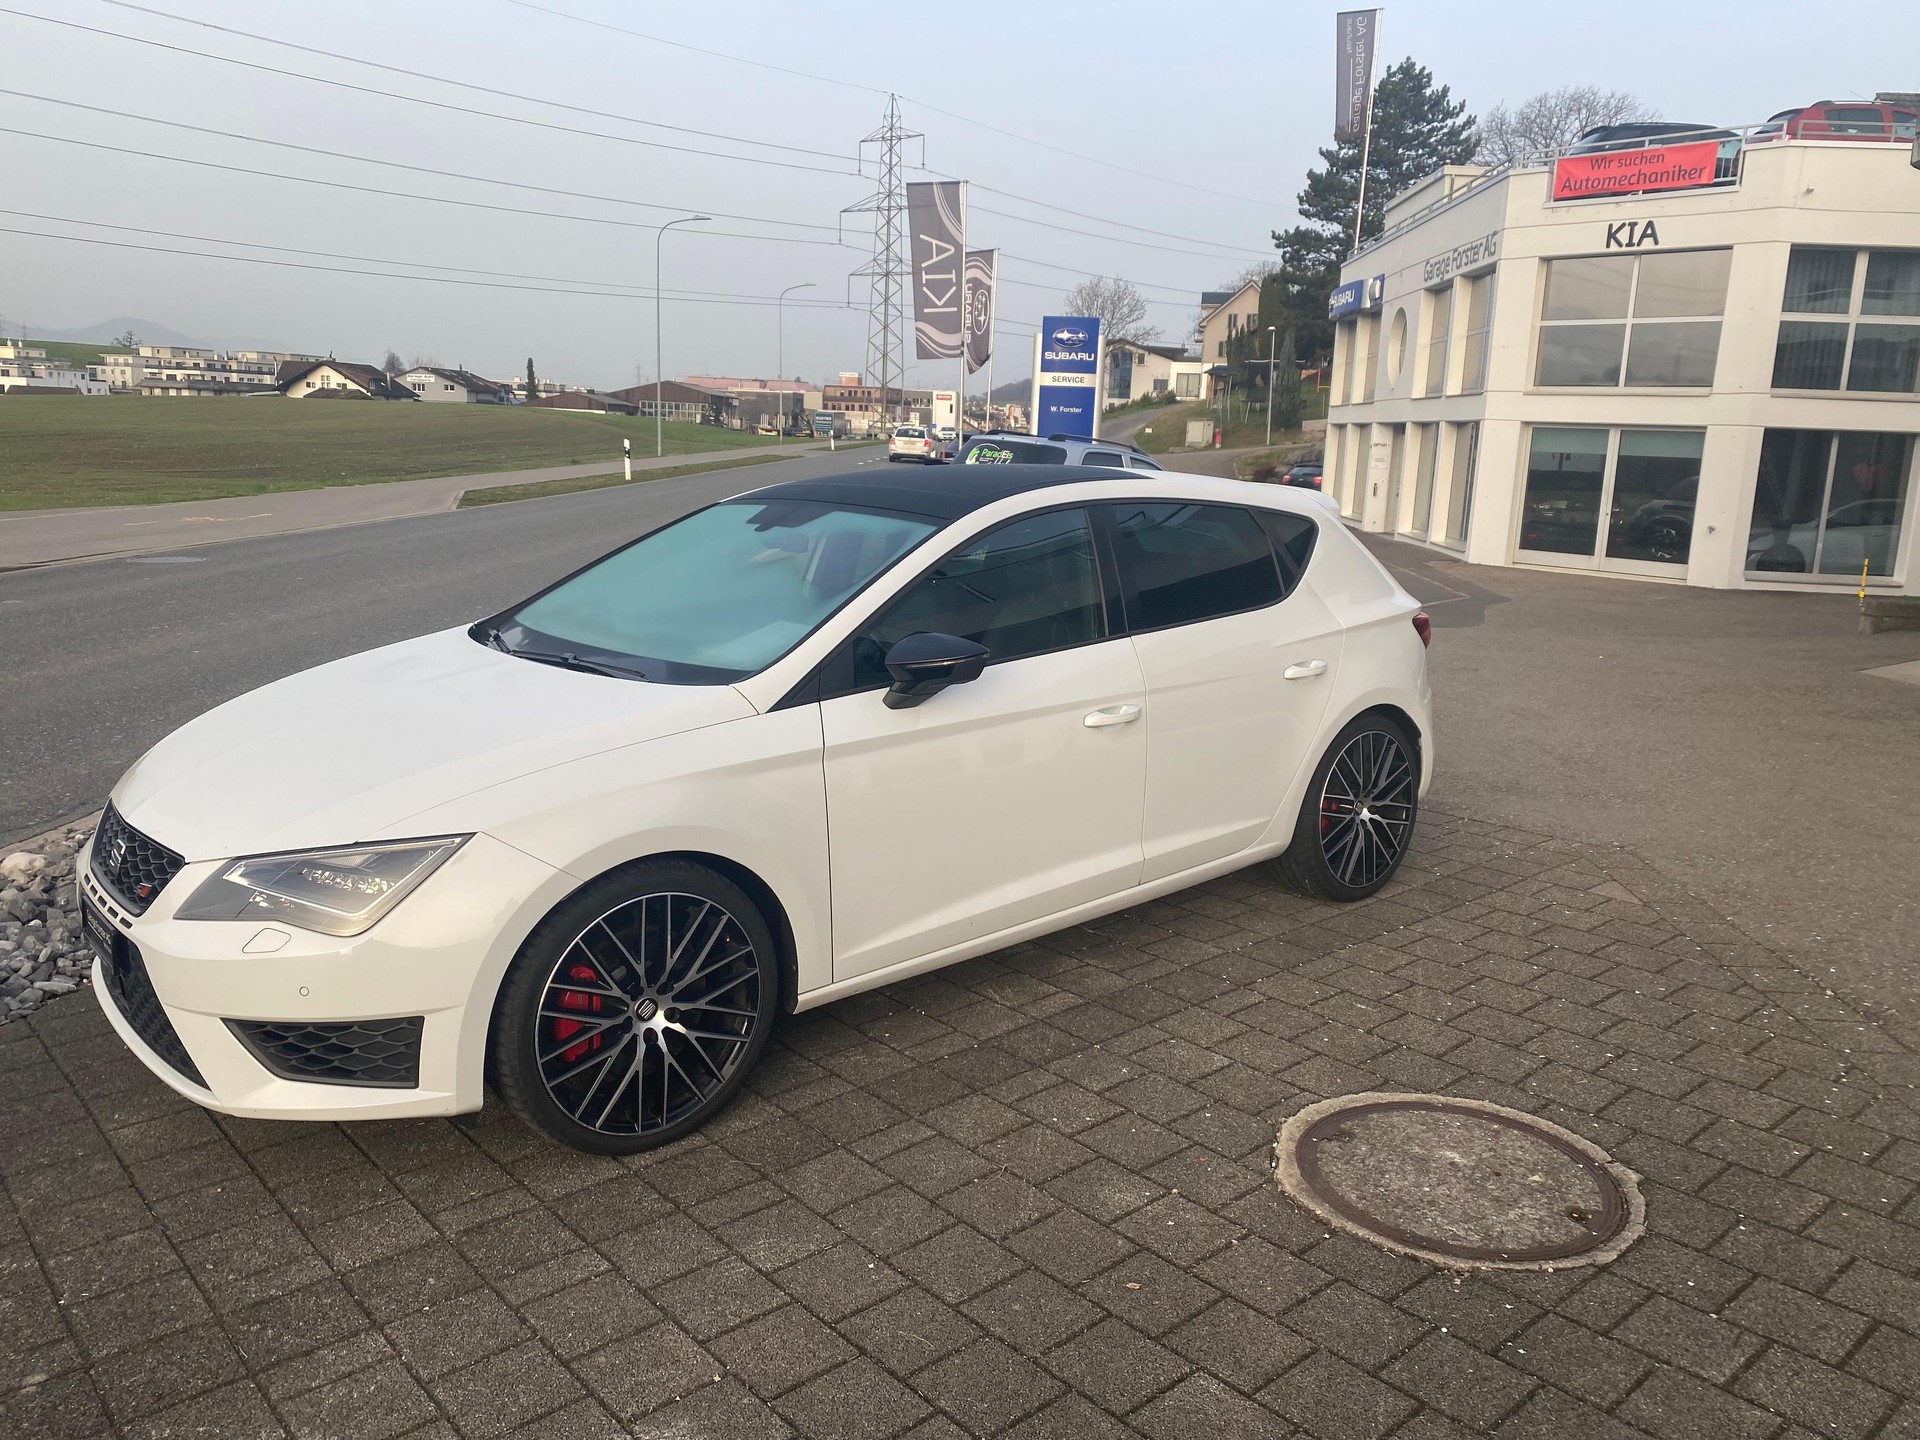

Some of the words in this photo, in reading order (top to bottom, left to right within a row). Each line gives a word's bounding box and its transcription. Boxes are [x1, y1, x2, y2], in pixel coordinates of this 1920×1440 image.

[1590, 156, 1614, 171] Wir
[1617, 152, 1665, 168] suchen
[1561, 164, 1707, 192] Automechaniker
[1605, 219, 1660, 249] KIA
[1423, 256, 1450, 282] Garage
[1451, 240, 1483, 271] Forster
[1482, 230, 1499, 260] AG
[1044, 351, 1095, 361] SUBARU
[1051, 375, 1086, 384] SERVICE
[1060, 405, 1083, 413] Forster
